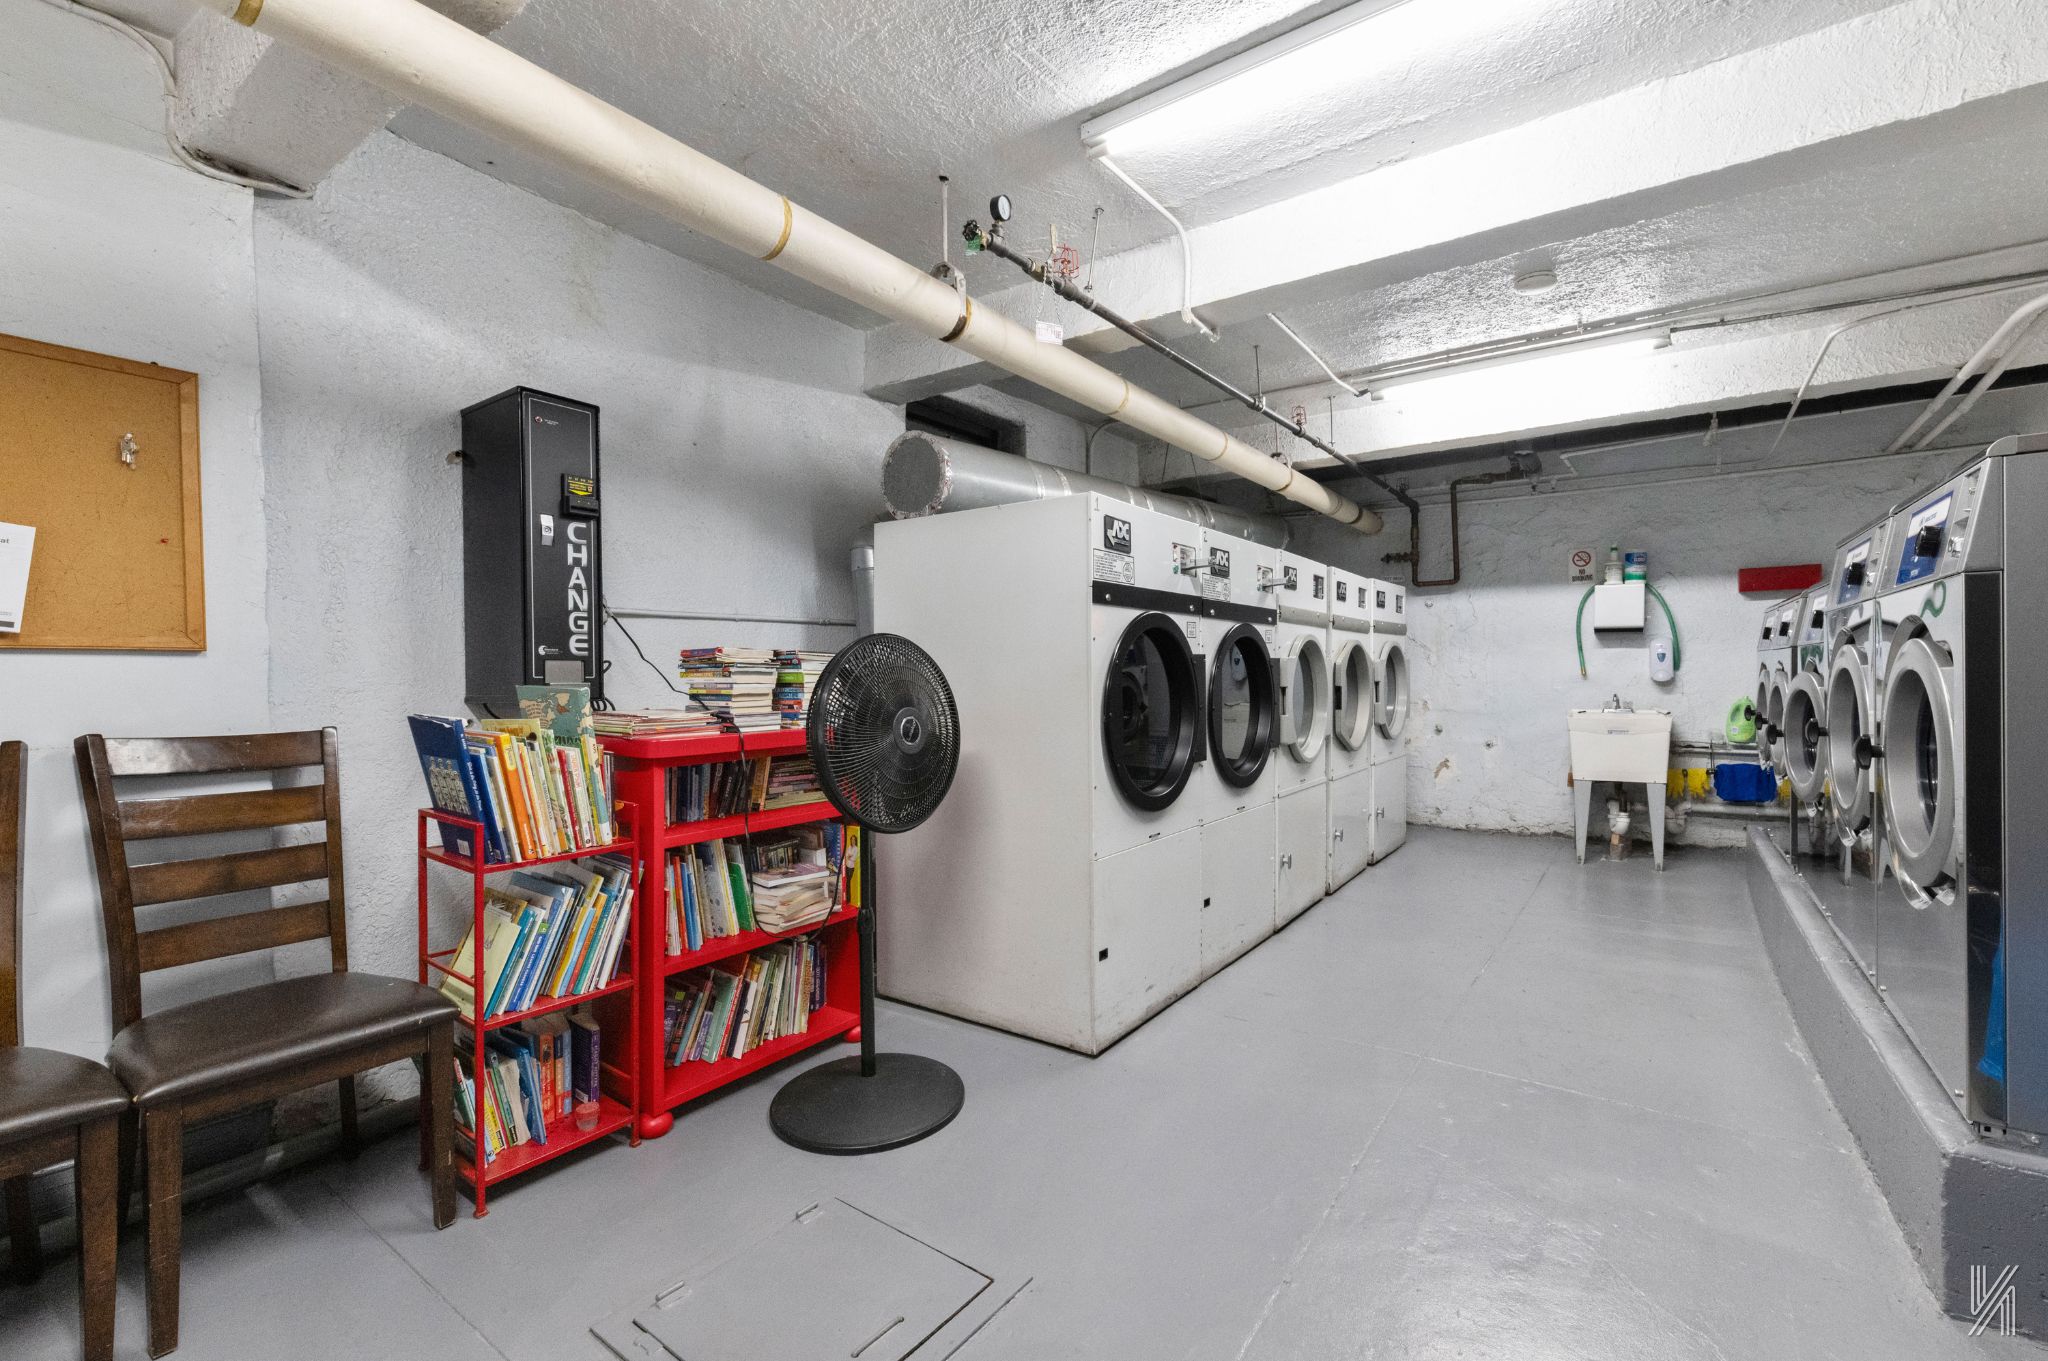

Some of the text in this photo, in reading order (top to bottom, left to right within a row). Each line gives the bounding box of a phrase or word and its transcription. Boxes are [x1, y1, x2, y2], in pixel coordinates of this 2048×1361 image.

[1112, 520, 1130, 541] ADC
[1216, 551, 1229, 567] ADC
[567, 521, 589, 657] CHANGE
